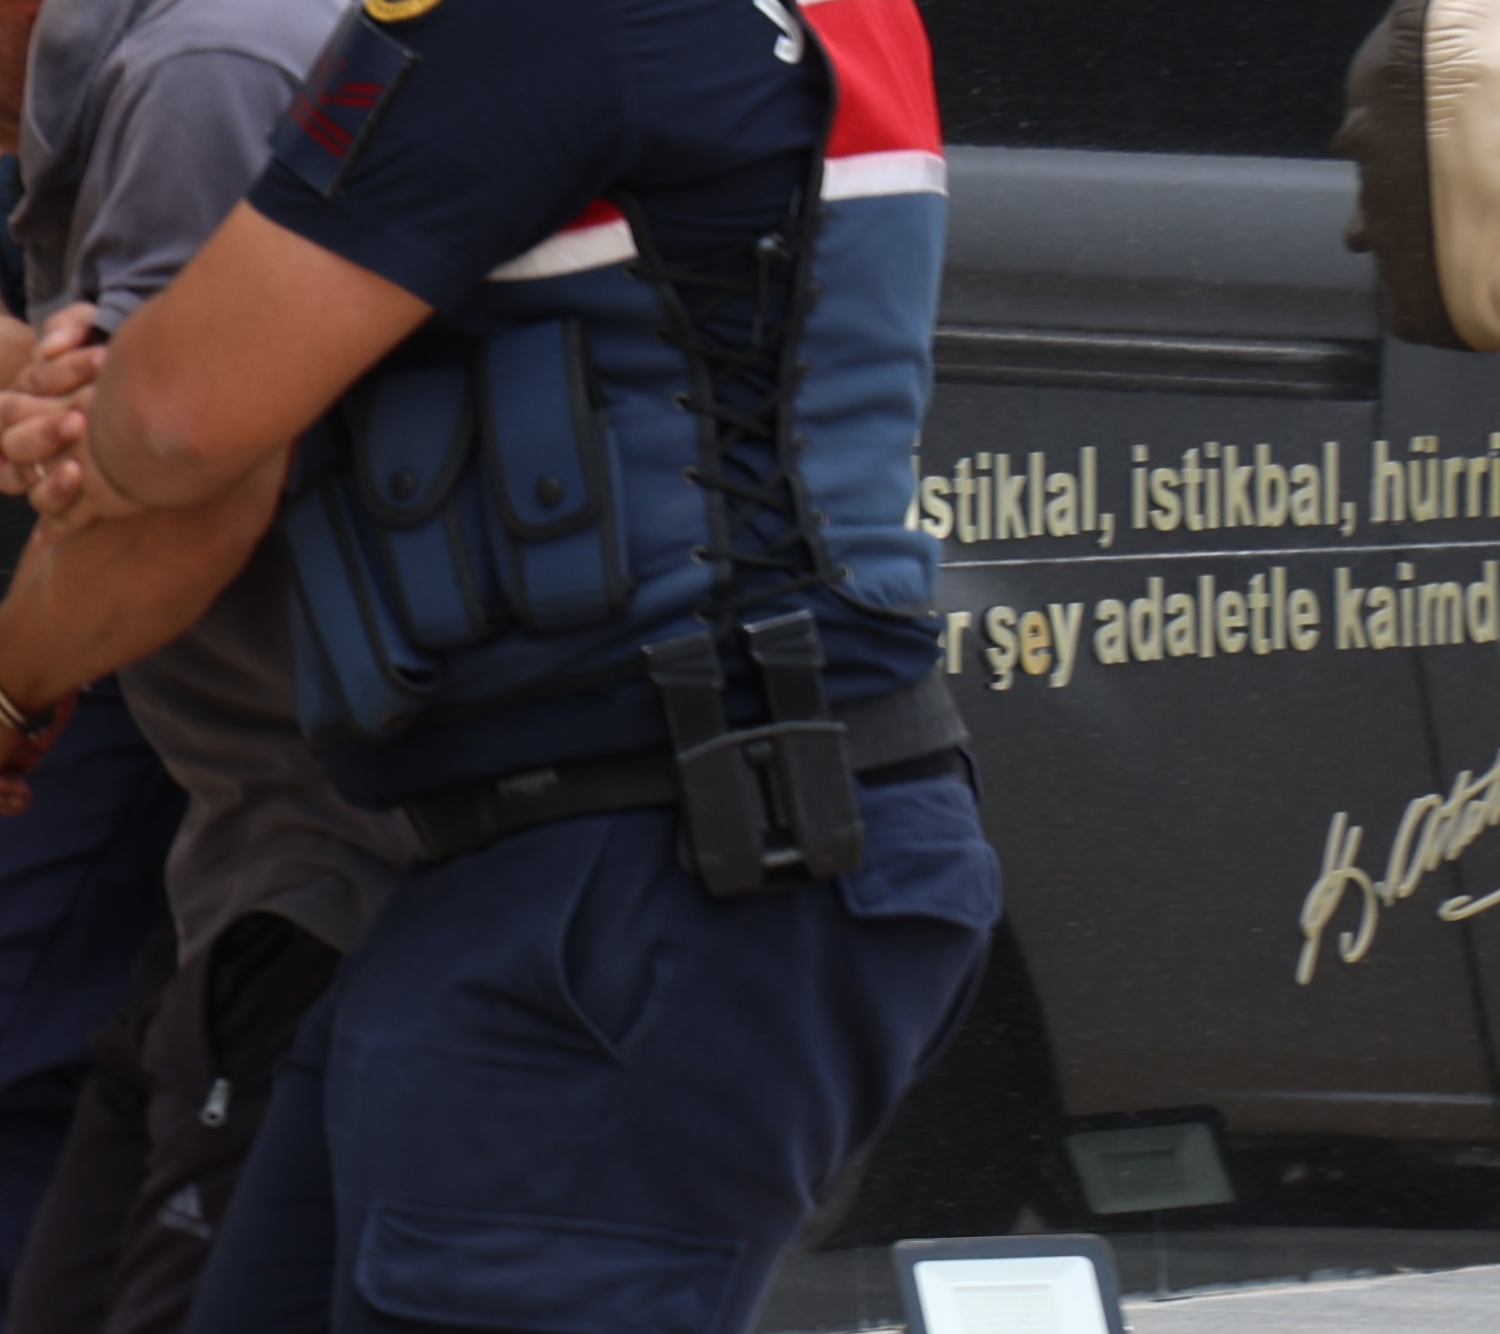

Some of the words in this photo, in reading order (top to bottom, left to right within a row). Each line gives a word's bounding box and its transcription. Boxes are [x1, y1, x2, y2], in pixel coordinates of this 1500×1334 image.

[1131, 441, 1357, 538] istikbal,
[983, 602, 1084, 691] şey
[1093, 566, 1321, 665] adaletle
